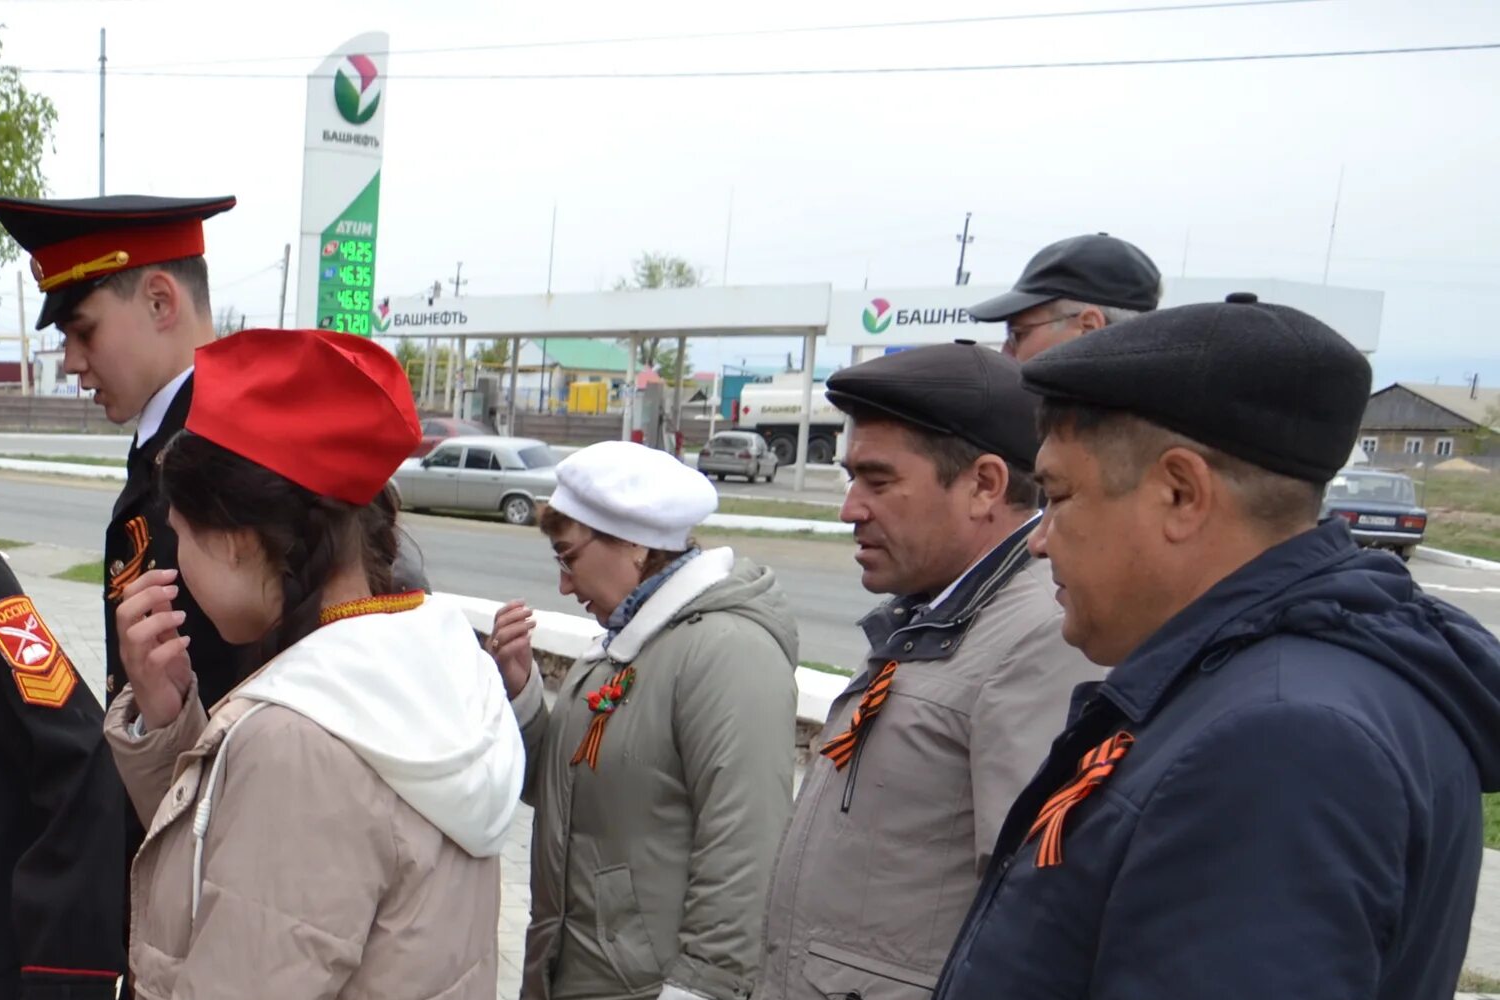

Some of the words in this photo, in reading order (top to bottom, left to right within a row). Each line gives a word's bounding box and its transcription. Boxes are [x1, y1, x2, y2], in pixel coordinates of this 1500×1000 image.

[322, 129, 380, 147] БАШНЕФТЬ
[394, 310, 468, 326] БАШНЕФТЬ
[896, 308, 978, 325] БАШНЕ
